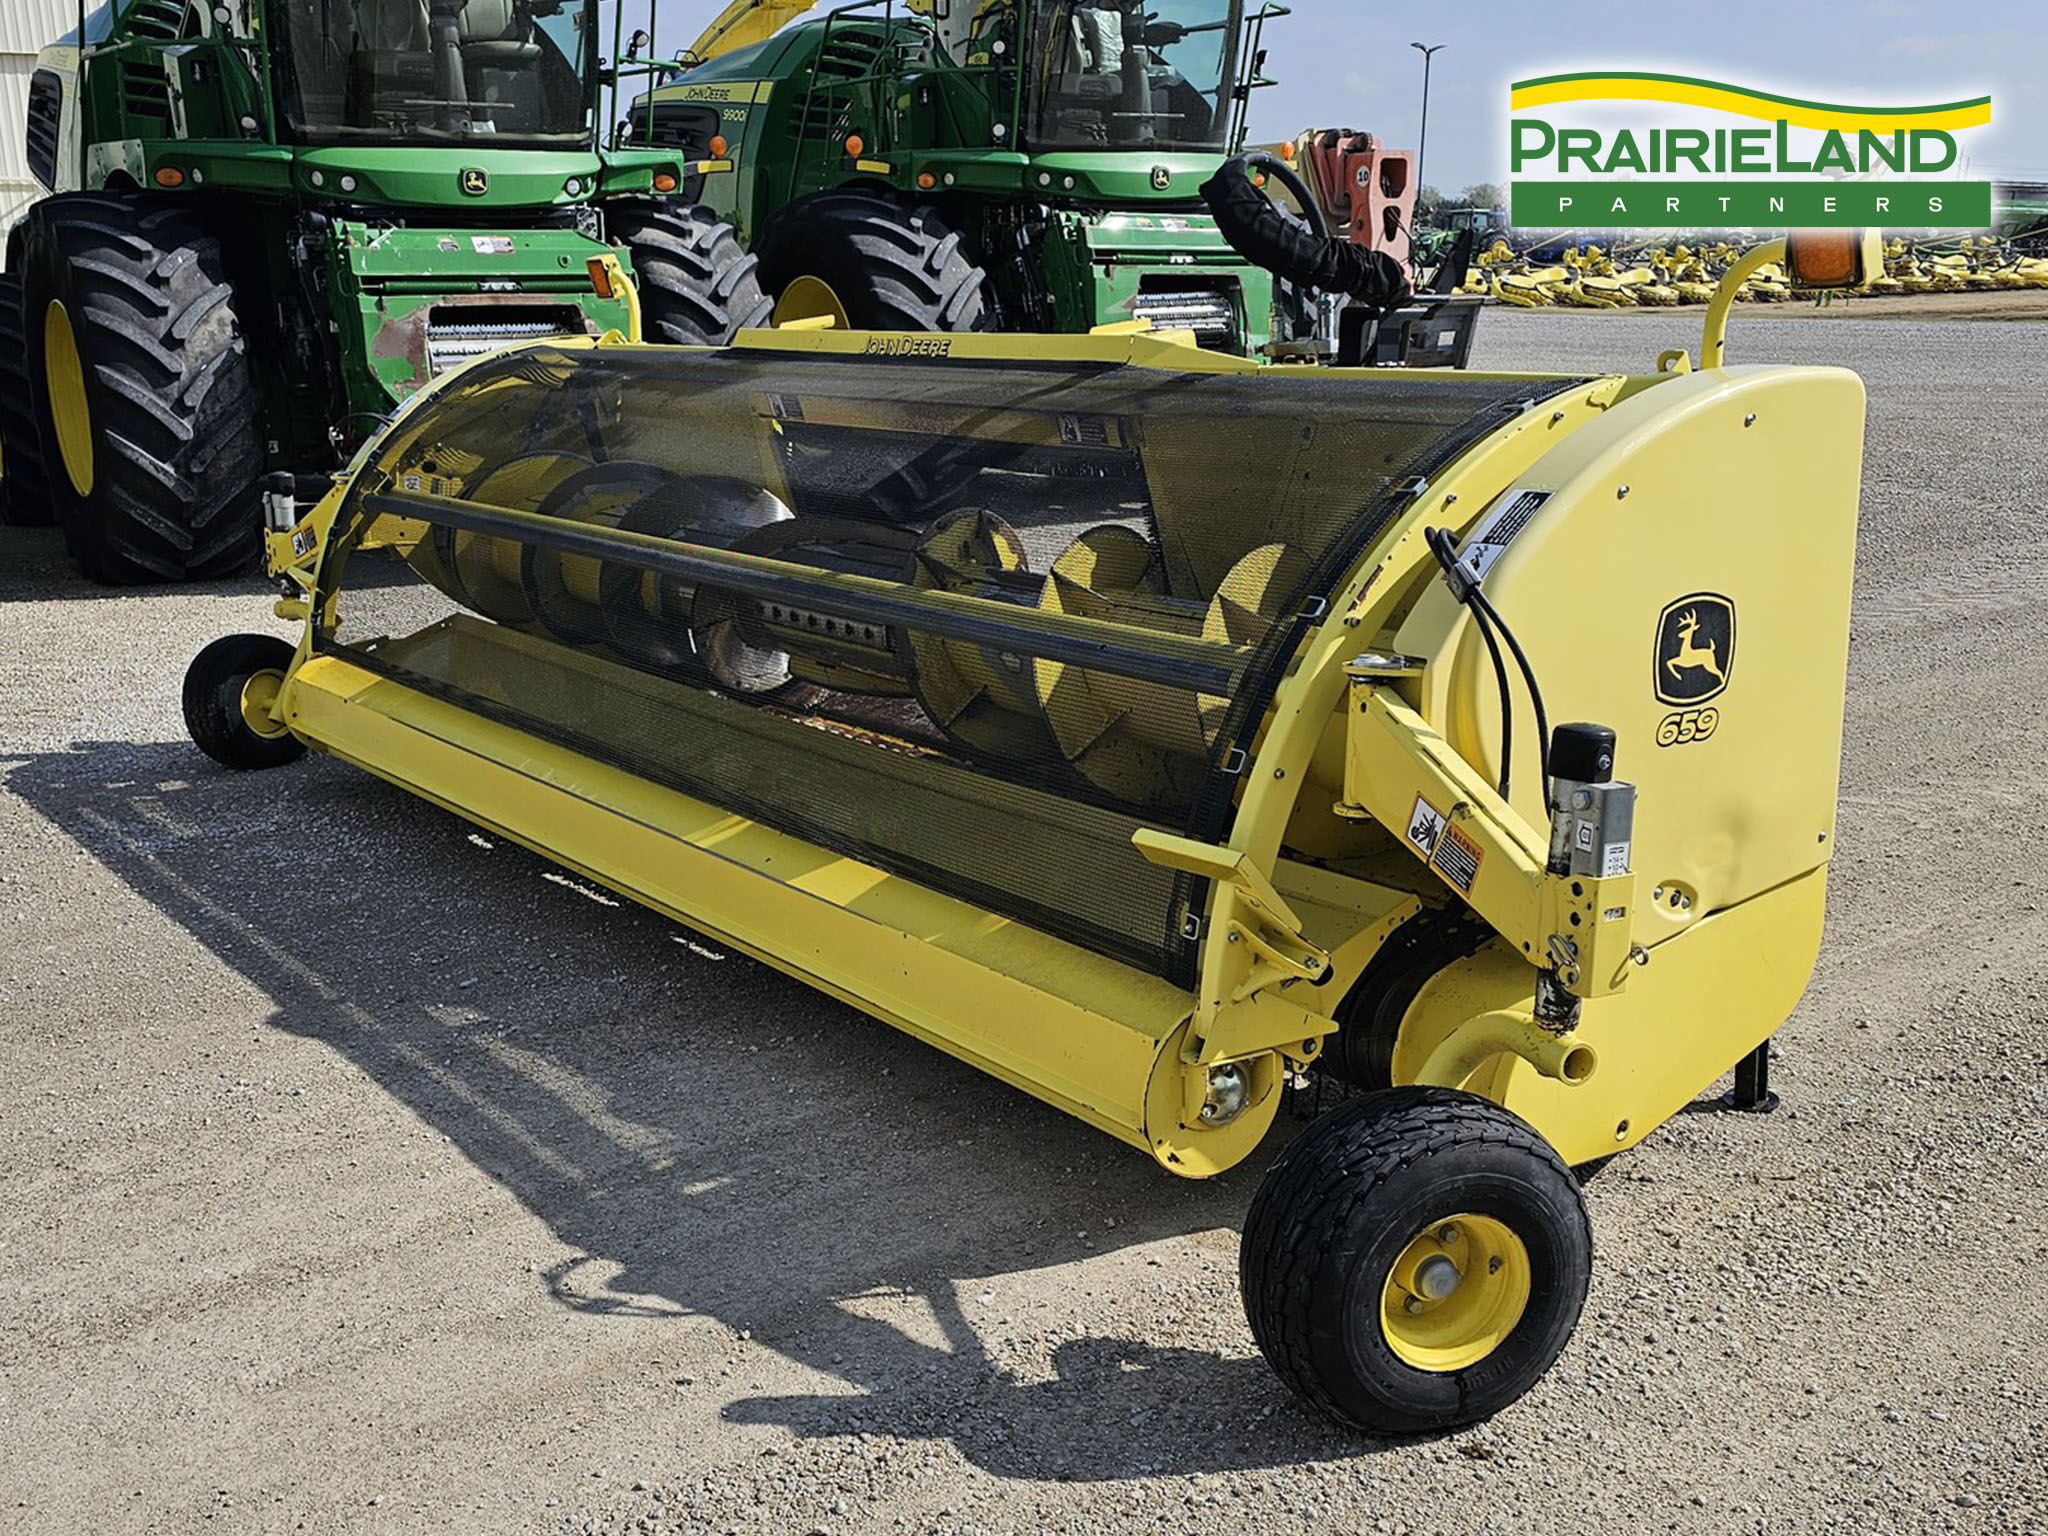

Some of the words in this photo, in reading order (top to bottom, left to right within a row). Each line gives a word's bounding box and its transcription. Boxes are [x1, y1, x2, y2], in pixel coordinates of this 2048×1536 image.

[704, 86, 731, 101] DEERE
[862, 336, 900, 356] JOHN
[901, 335, 952, 357] DEERE
[1656, 707, 1719, 747] 659
